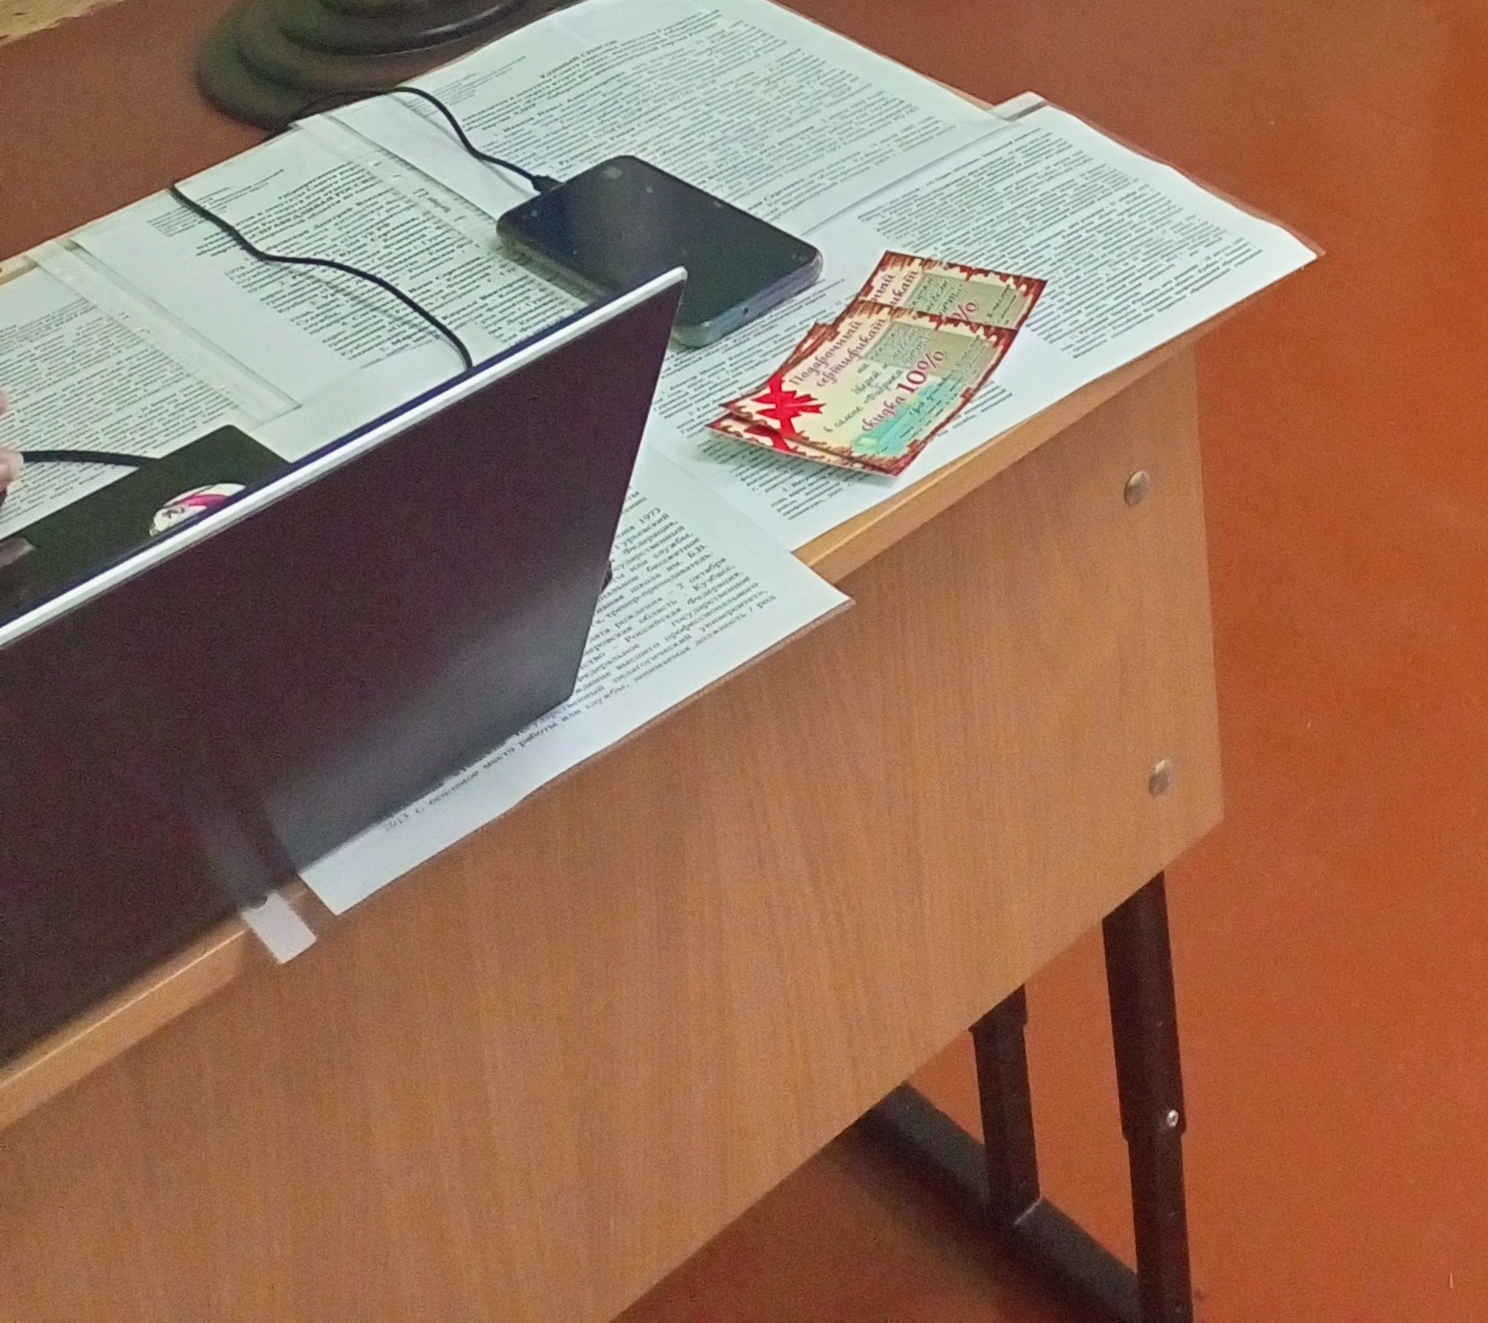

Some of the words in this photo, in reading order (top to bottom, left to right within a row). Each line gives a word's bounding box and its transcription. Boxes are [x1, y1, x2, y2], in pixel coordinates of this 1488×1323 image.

[789, 320, 862, 386] Подарочный
[816, 318, 886, 388] сертификат
[857, 362, 869, 374] на
[861, 392, 905, 432] скидка
[896, 350, 946, 396] 10%
[636, 506, 664, 524] 1973
